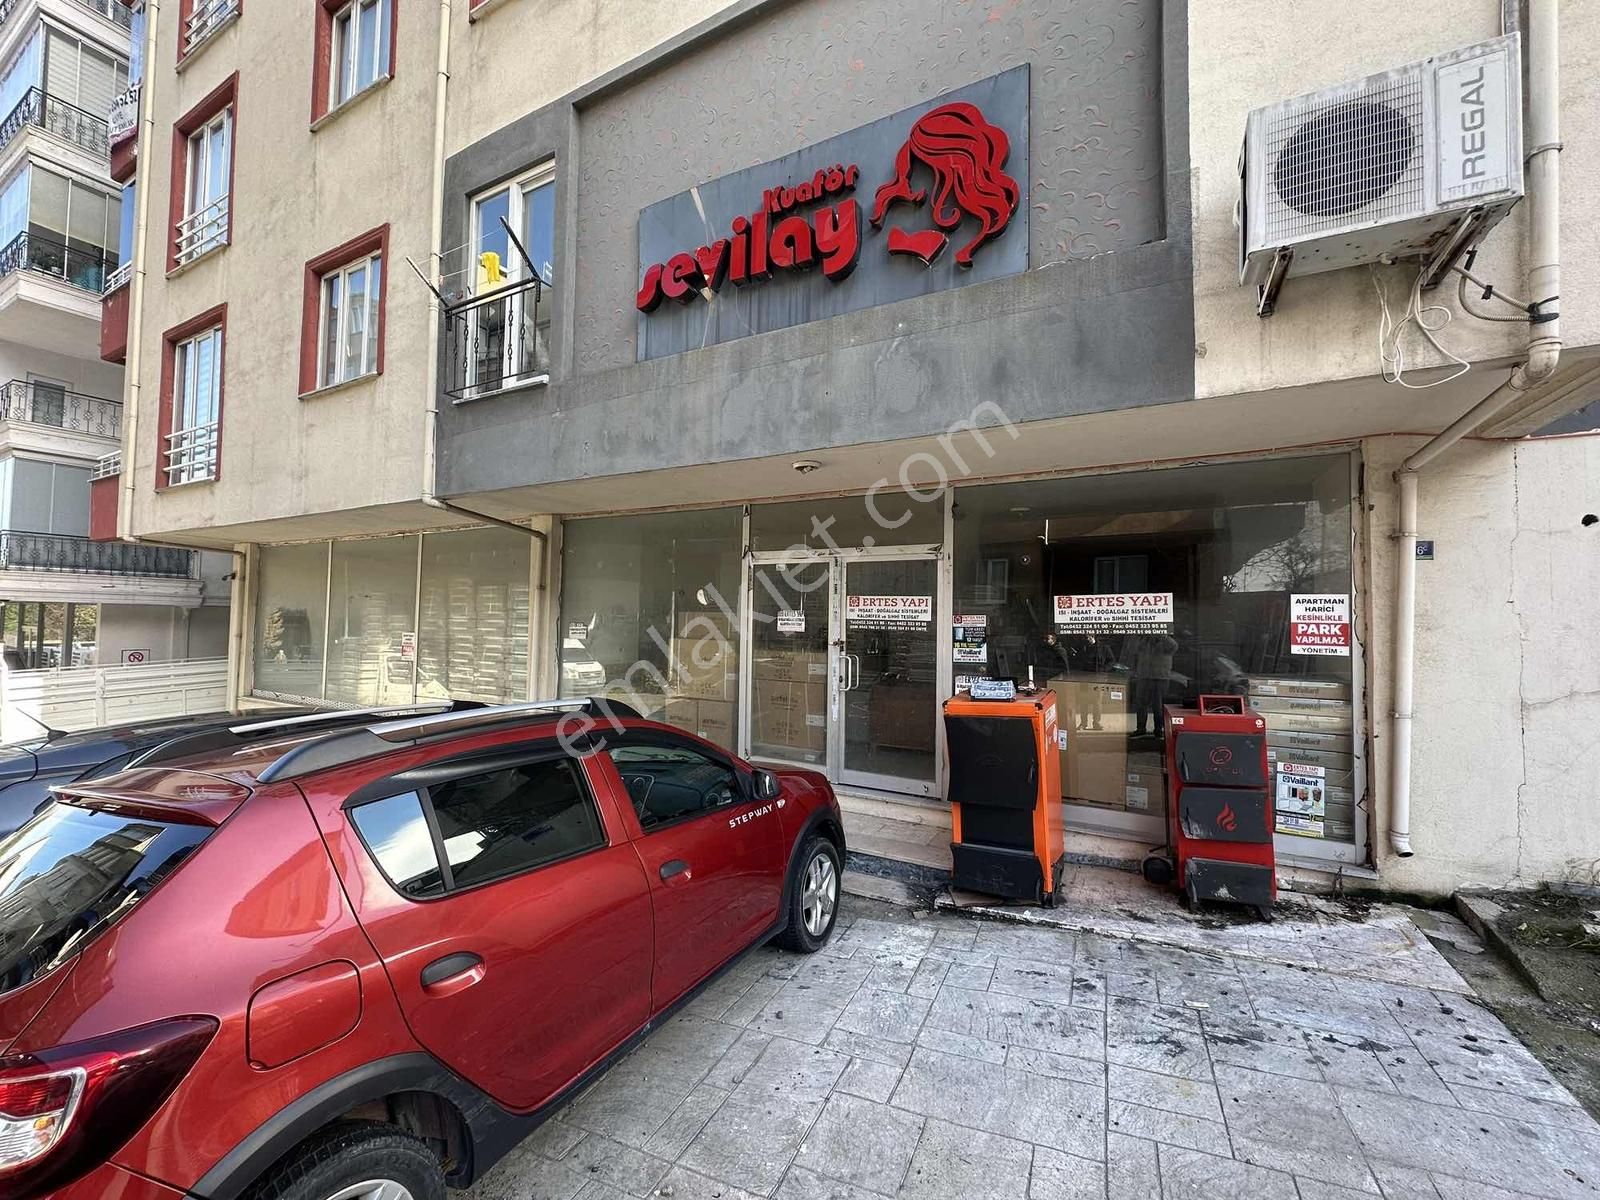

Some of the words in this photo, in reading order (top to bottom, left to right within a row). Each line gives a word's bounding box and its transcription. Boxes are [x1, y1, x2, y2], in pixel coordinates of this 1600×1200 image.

[1460, 66, 1486, 180] REGAL
[763, 164, 860, 213] Kuaför
[636, 199, 863, 314] sevilay
[863, 597, 898, 607] ERTES
[900, 598, 929, 607] YAPI
[1076, 597, 1125, 607] ERTES
[1129, 596, 1169, 606] YAPI
[1296, 613, 1343, 621] KESİNLİKLE
[1297, 623, 1343, 635] PARK
[1295, 635, 1345, 645] YAPILMAZ
[1290, 776, 1319, 786] Vaillant
[729, 804, 772, 828] STEPWAY
